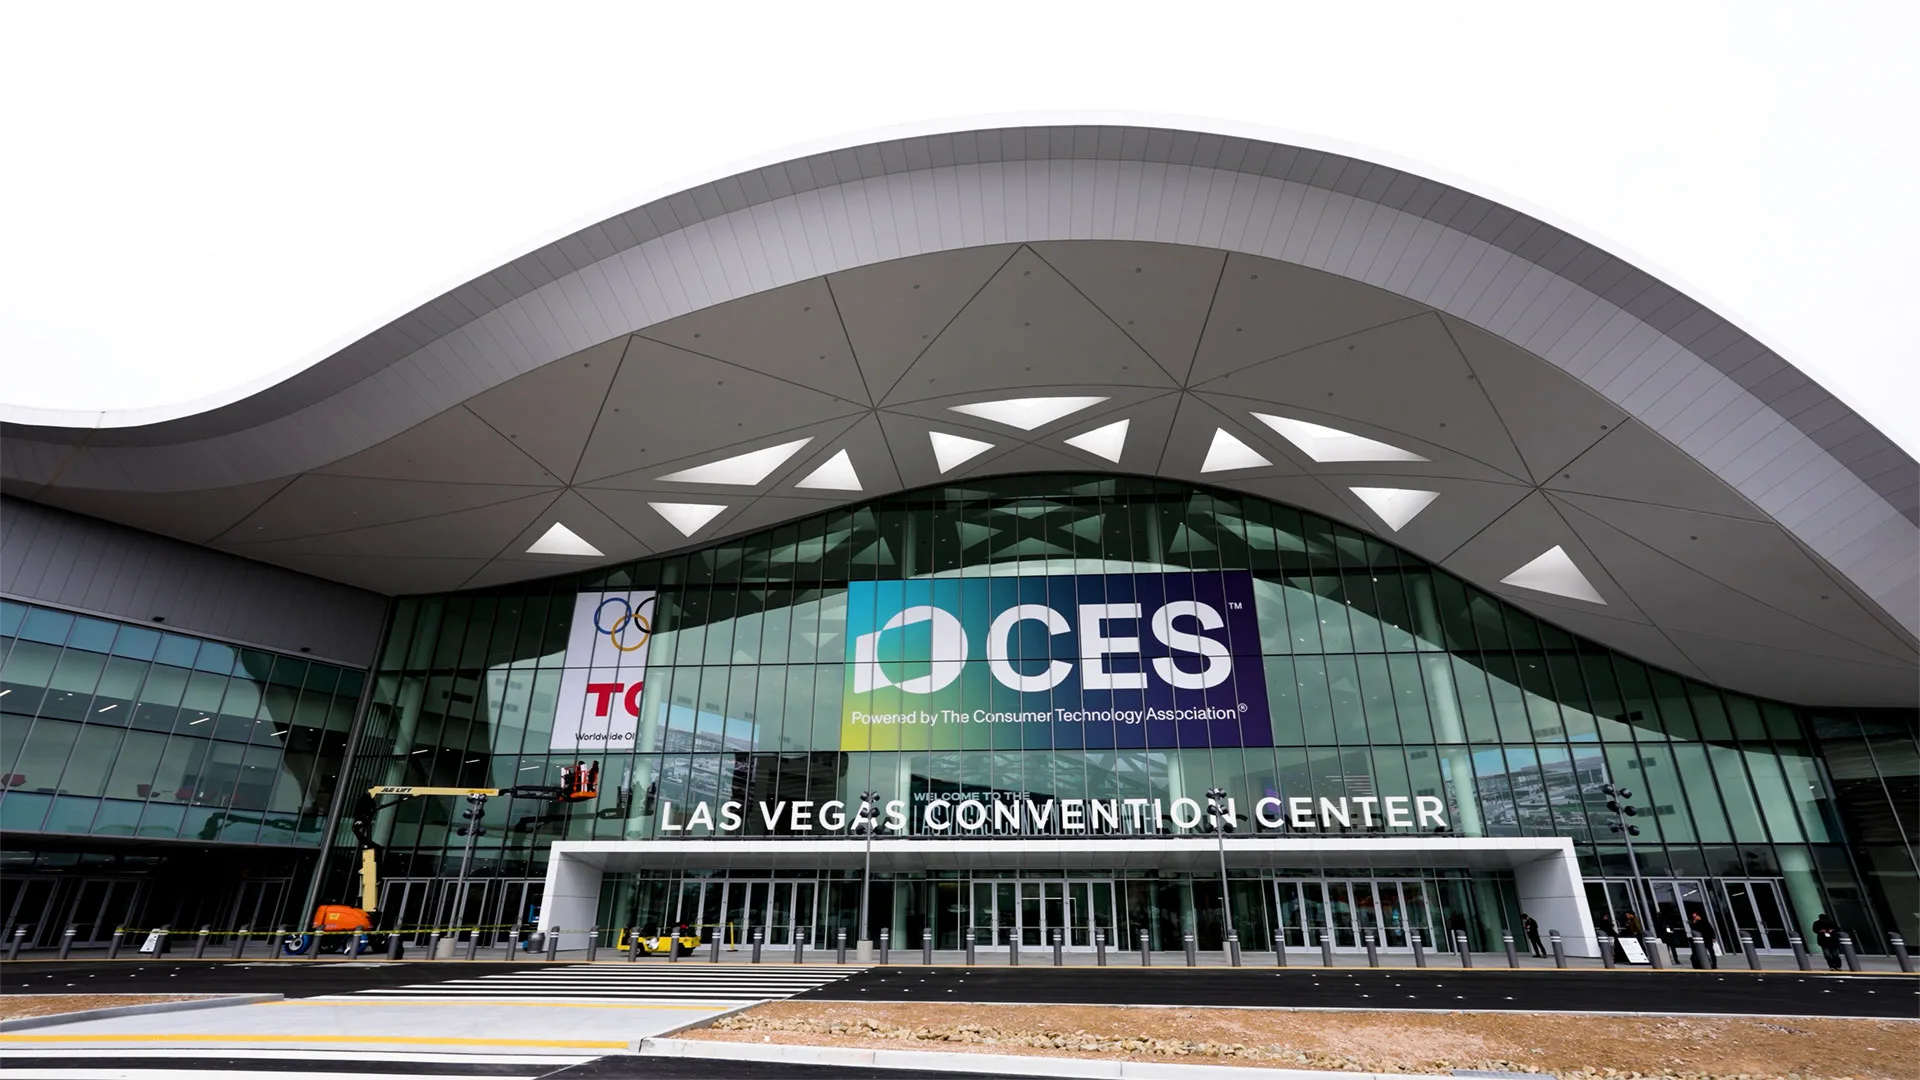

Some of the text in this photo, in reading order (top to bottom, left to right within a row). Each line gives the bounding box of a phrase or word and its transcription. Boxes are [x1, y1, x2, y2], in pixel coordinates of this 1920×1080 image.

[986, 600, 1231, 693] CES
[852, 711, 916, 725] Powered
[920, 711, 938, 727] by
[941, 710, 969, 723] The
[973, 709, 1052, 723] Consumer
[1055, 708, 1143, 724] Technology
[575, 732, 623, 741] Worldwide
[914, 791, 1031, 801] WELCOME TO THE
[661, 796, 1447, 831] LAS VEGAS CONVENTION CENTER
